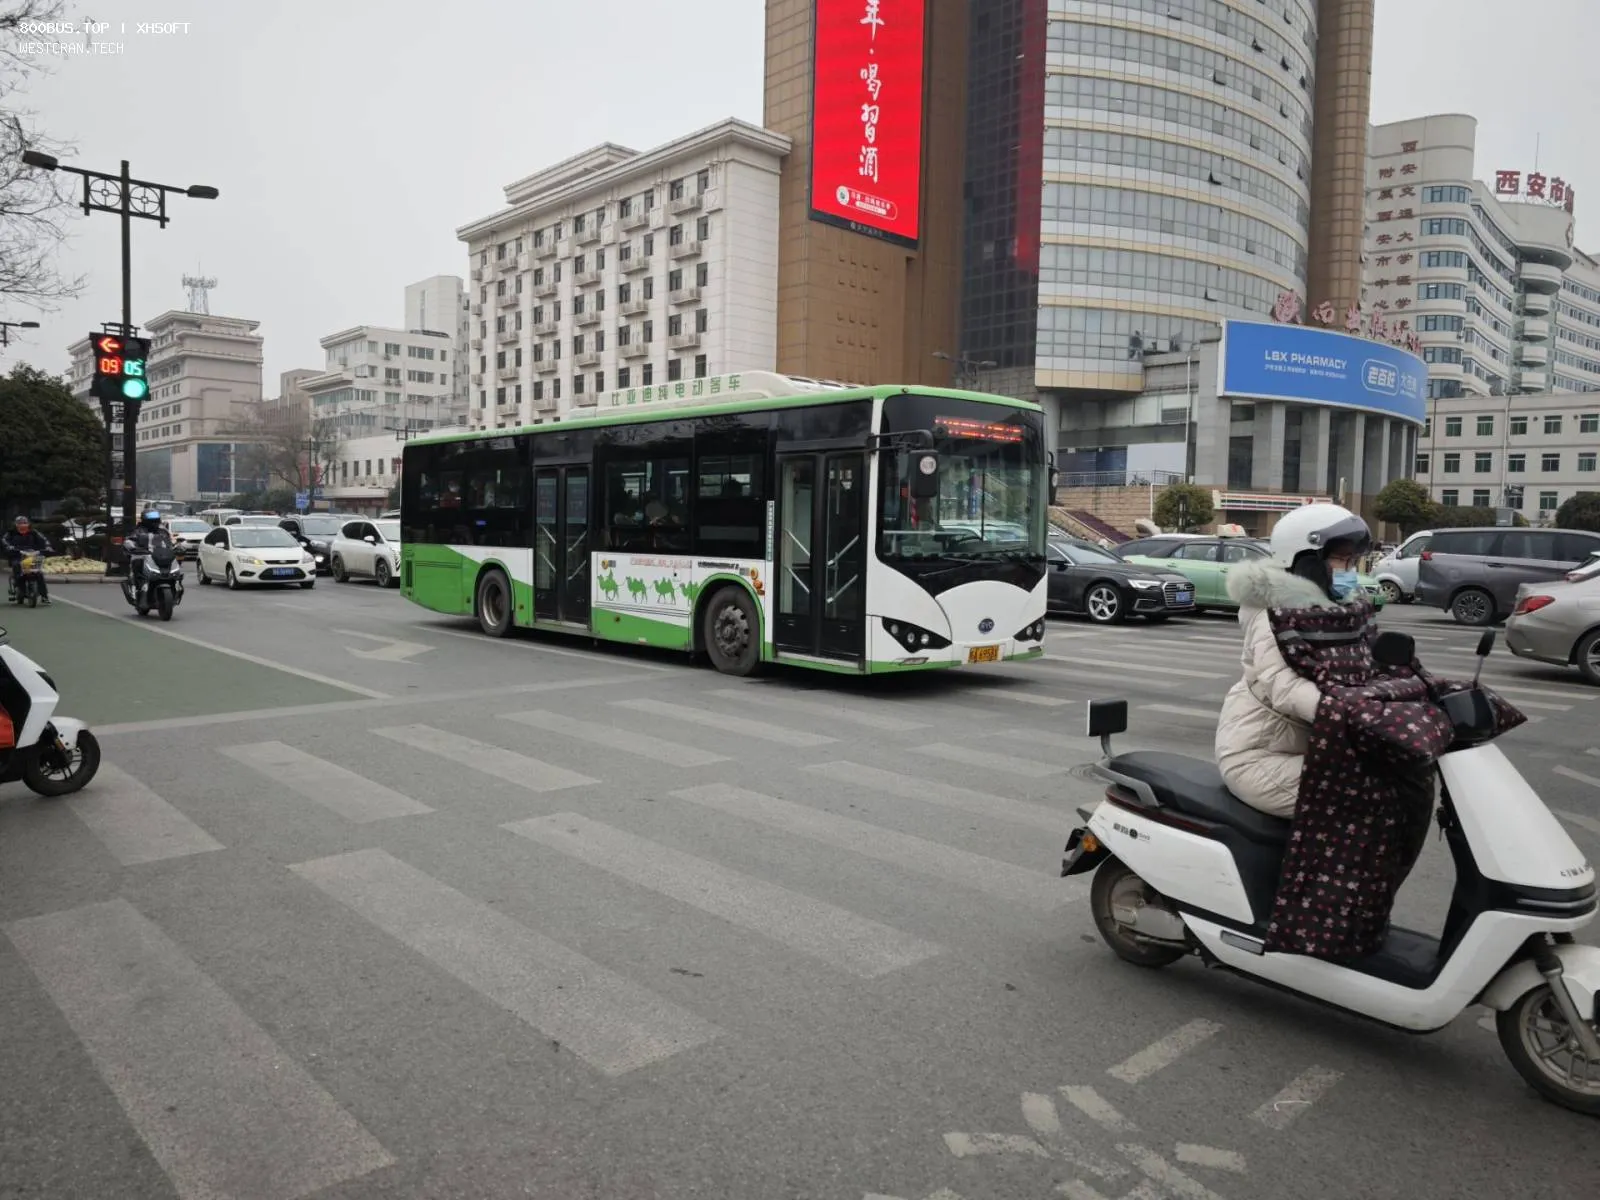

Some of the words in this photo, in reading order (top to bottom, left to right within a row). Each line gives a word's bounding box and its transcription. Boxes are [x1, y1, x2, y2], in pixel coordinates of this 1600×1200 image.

[101, 358, 119, 374] 09
[124, 360, 143, 376] 05
[1264, 349, 1288, 362] LBX
[1291, 352, 1348, 370] PHARMACY
[611, 374, 742, 407] 比亚迪纯电动客车
